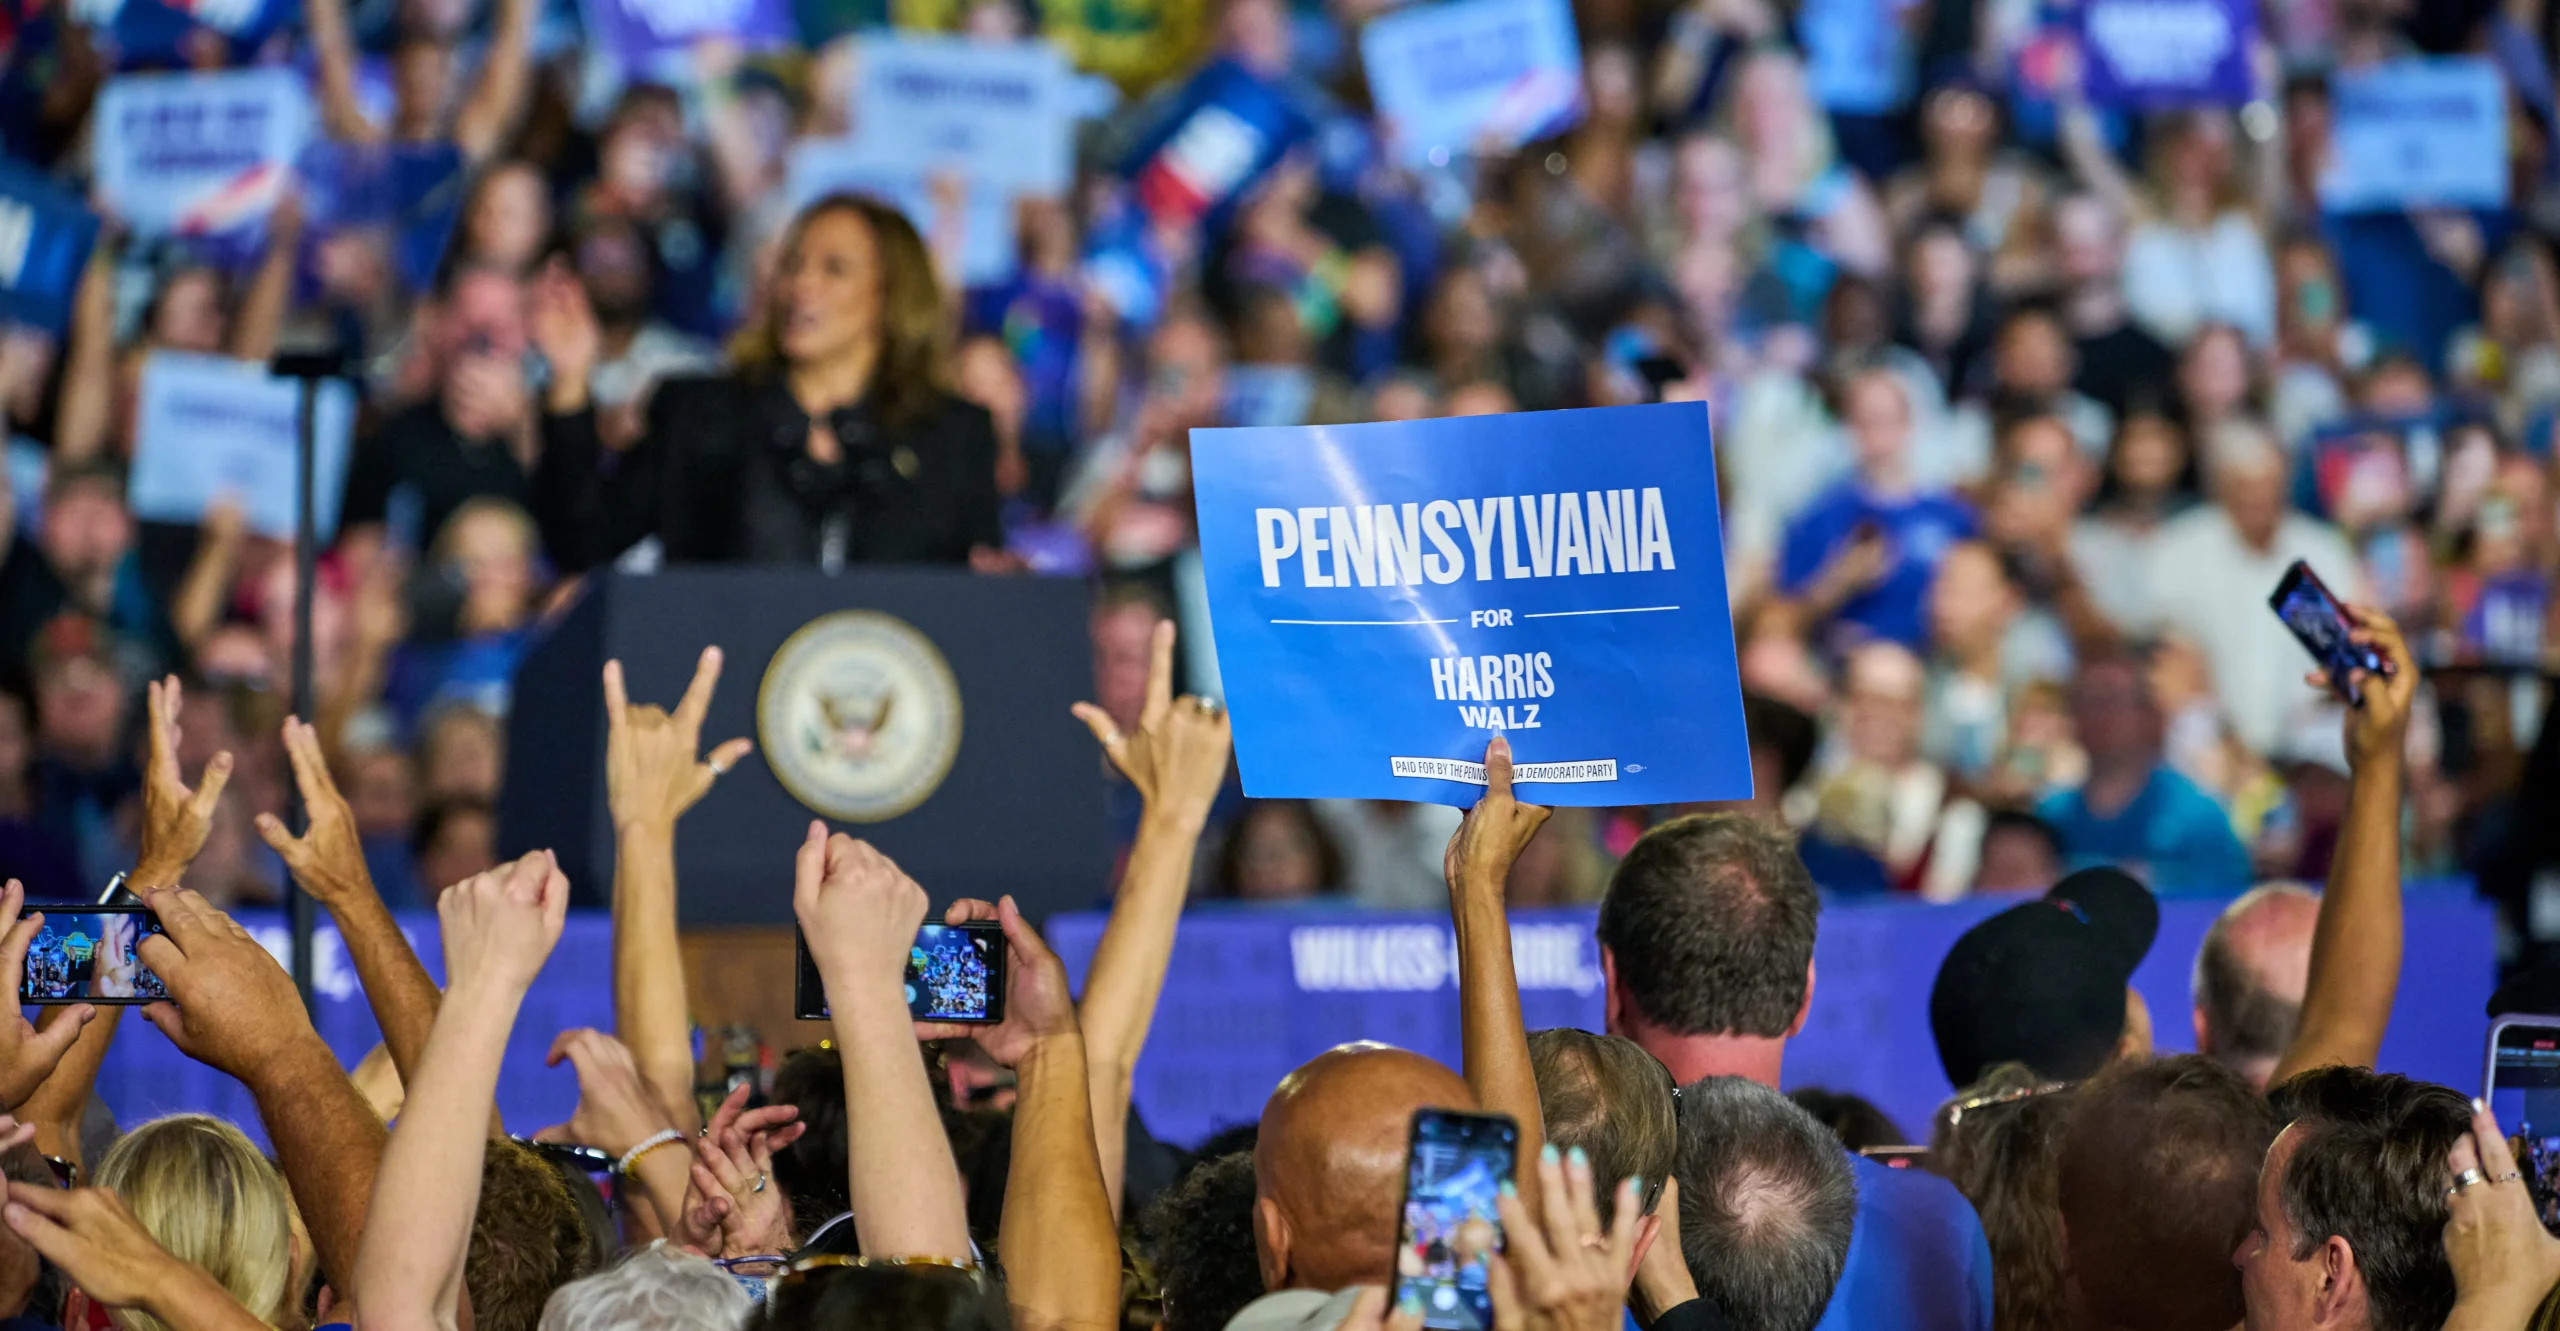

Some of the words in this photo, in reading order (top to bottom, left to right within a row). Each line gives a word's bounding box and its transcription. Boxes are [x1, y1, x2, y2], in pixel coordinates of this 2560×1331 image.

[1256, 487, 1675, 588] PENNSYLVANIA
[1471, 608, 1513, 630] FOR
[1430, 651, 1555, 700] HARRIS
[1458, 704, 1541, 730] WALZ
[1395, 760, 1416, 773] PAID
[1418, 761, 1435, 775] FOR
[1437, 763, 1448, 776] BY
[1449, 763, 1463, 778] THE
[1526, 766, 1585, 779] DEMOCRATIC
[1586, 763, 1613, 778] PARTY
